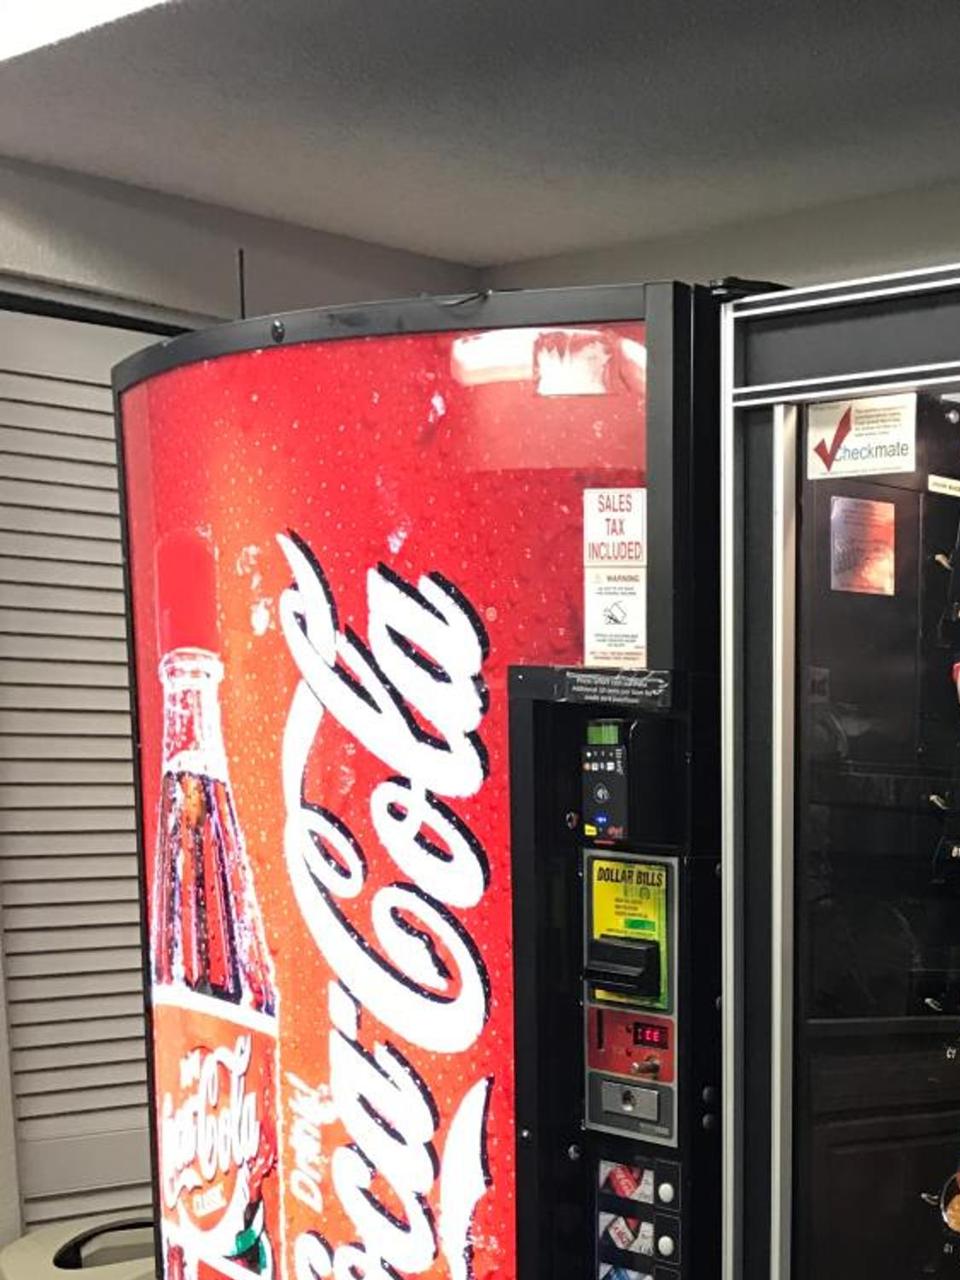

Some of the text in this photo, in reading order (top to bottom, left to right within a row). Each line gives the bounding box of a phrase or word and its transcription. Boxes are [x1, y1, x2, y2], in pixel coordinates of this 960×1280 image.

[598, 494, 632, 512] SALES
[605, 518, 625, 536] TAX
[588, 541, 642, 561] INCLUDED
[597, 866, 664, 887] DOLLAR BILLS
